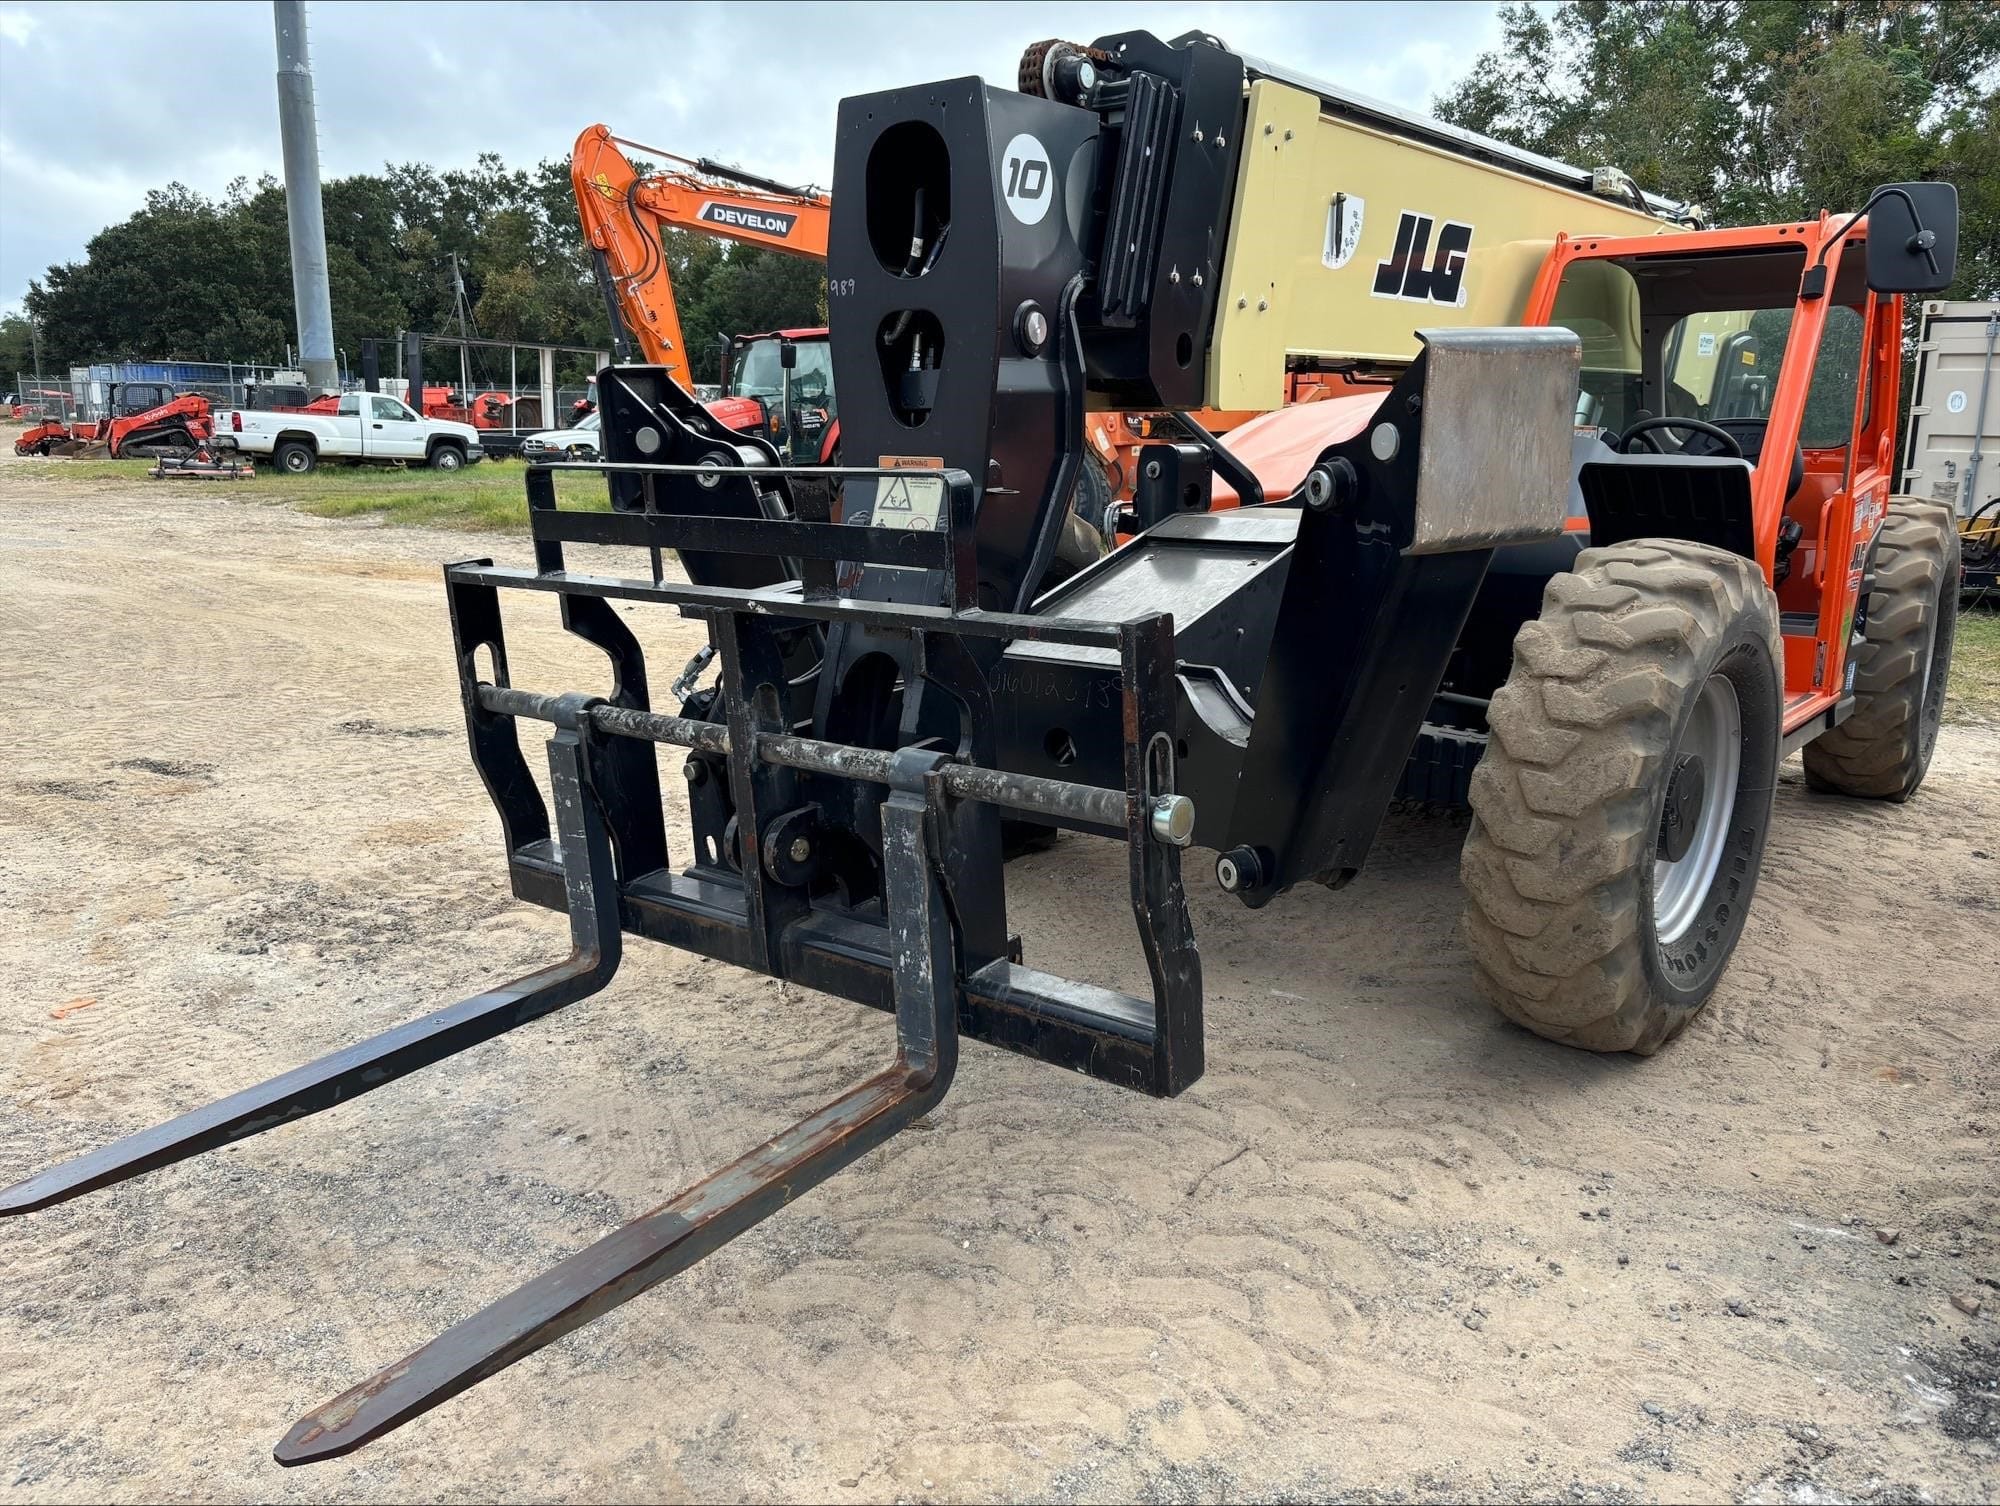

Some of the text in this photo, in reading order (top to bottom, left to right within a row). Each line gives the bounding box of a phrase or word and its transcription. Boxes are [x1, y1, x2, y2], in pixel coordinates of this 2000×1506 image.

[1007, 157, 1047, 199] 10
[713, 207, 788, 233] DEVELON
[1373, 213, 1473, 303] JLG
[830, 278, 856, 297] 989
